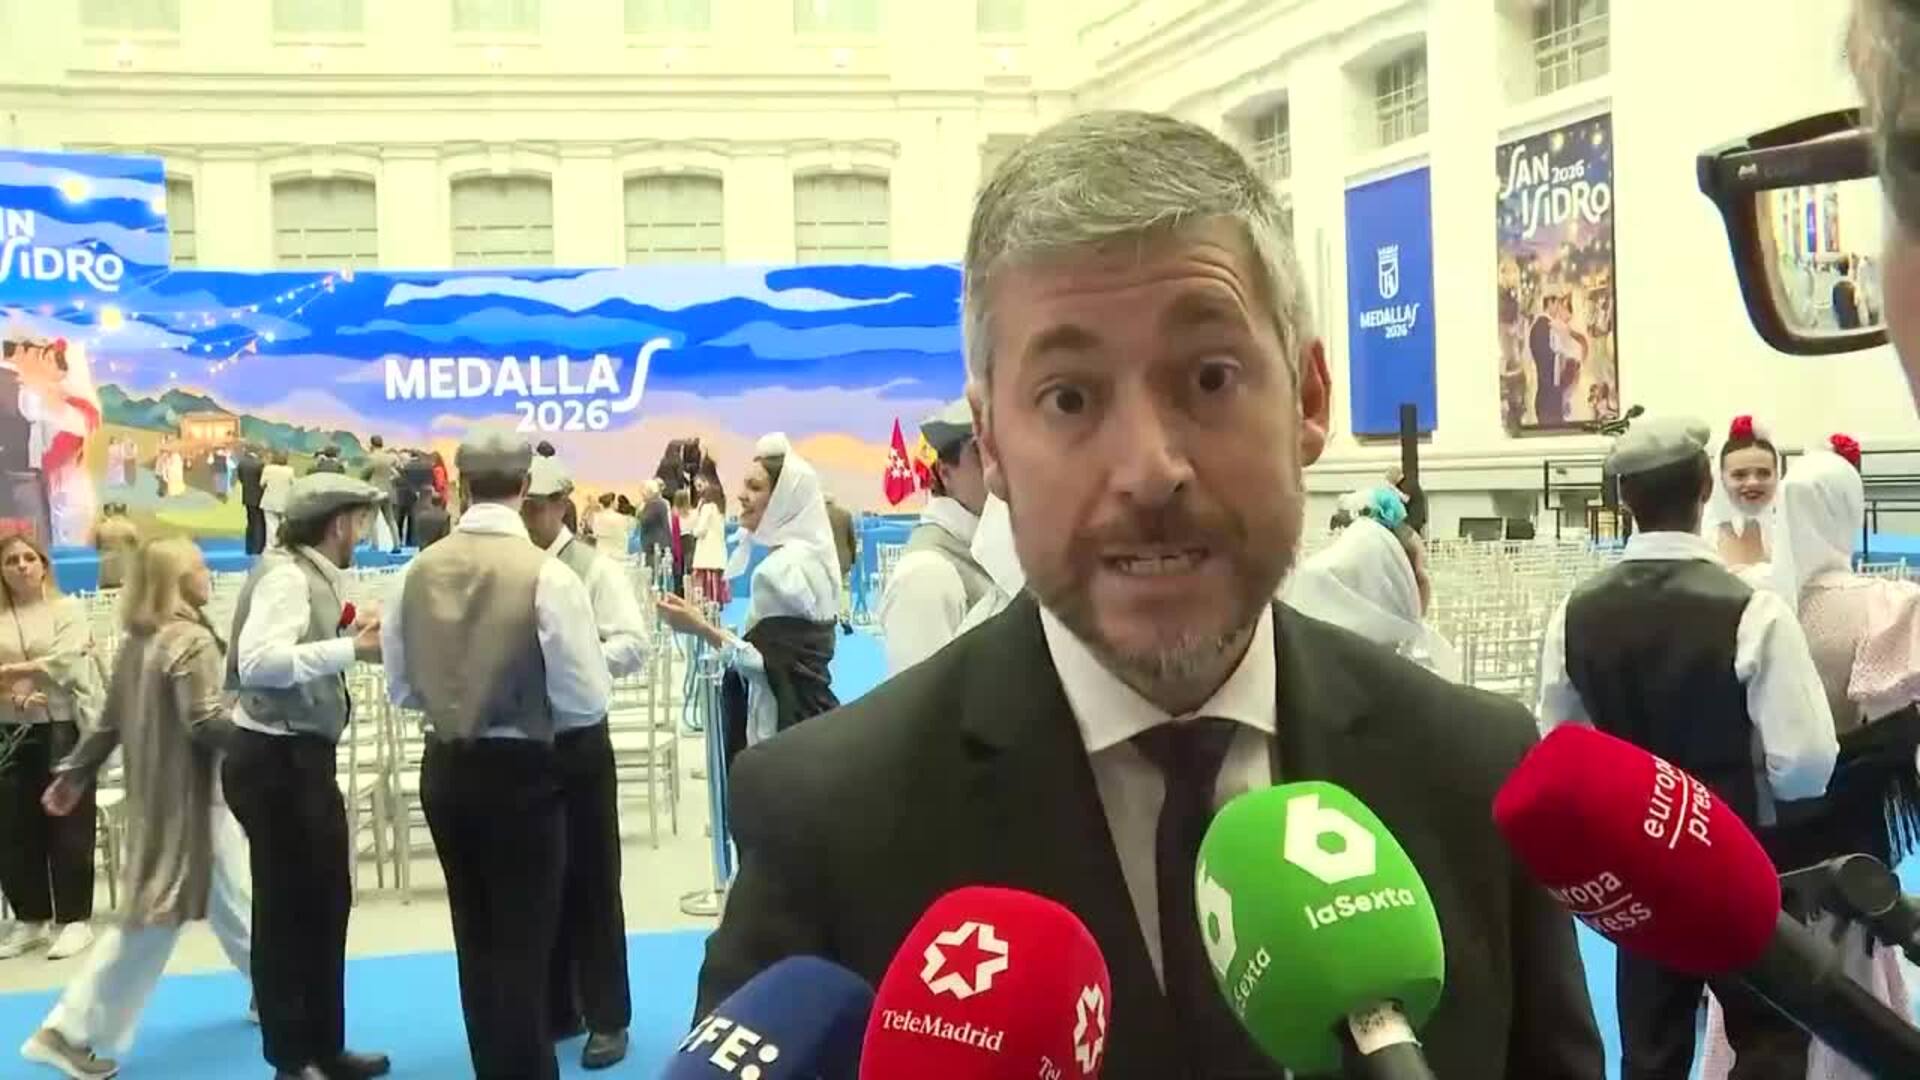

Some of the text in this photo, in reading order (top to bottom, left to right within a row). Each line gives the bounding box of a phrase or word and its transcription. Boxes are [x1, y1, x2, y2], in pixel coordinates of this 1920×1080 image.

[1499, 143, 1585, 200] SAN 2026
[1521, 180, 1611, 241] ISIDRO
[1360, 302, 1421, 329] MEDALLAS
[1385, 323, 1408, 339] 2026
[384, 337, 671, 413] MEDALLAS
[515, 399, 610, 433] 2026
[1304, 887, 1416, 930] laSexta
[882, 1009, 1004, 1052] TeleMadrid
